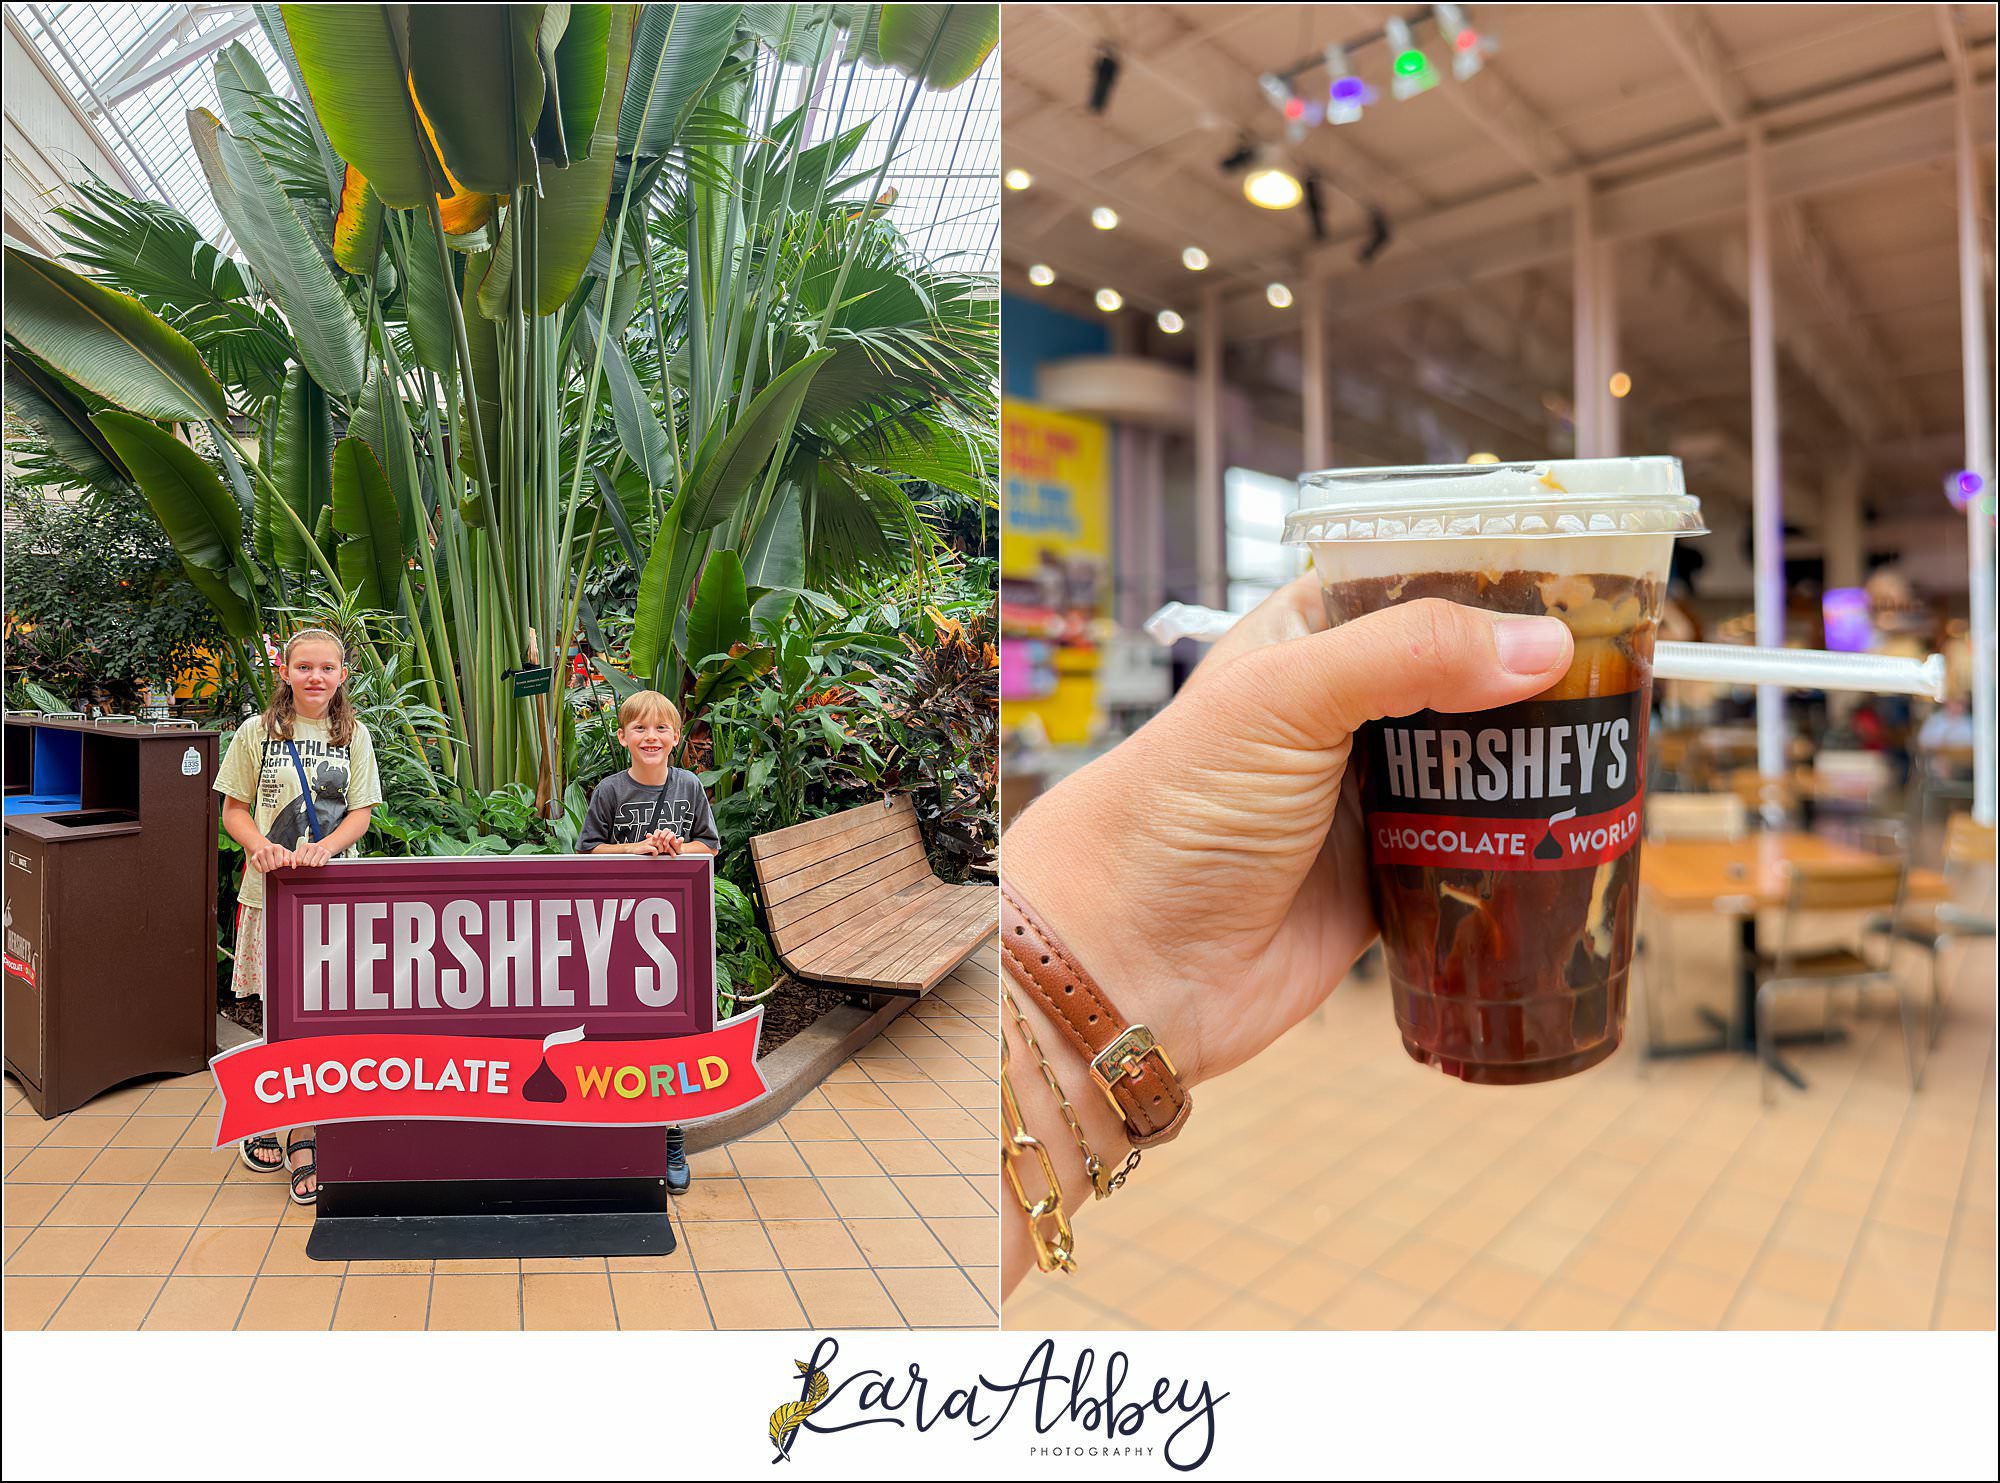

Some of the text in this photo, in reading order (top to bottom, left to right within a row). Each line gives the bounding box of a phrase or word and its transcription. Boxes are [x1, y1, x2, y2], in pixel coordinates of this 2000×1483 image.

[1384, 718, 1629, 801] HERSHEY'S
[614, 800, 694, 825] STAR
[1378, 812, 1637, 855] CHOCOLATE WORLD
[303, 897, 679, 1011] HERSHEY'S
[253, 1055, 729, 1104] CHOCOLATE WORLD
